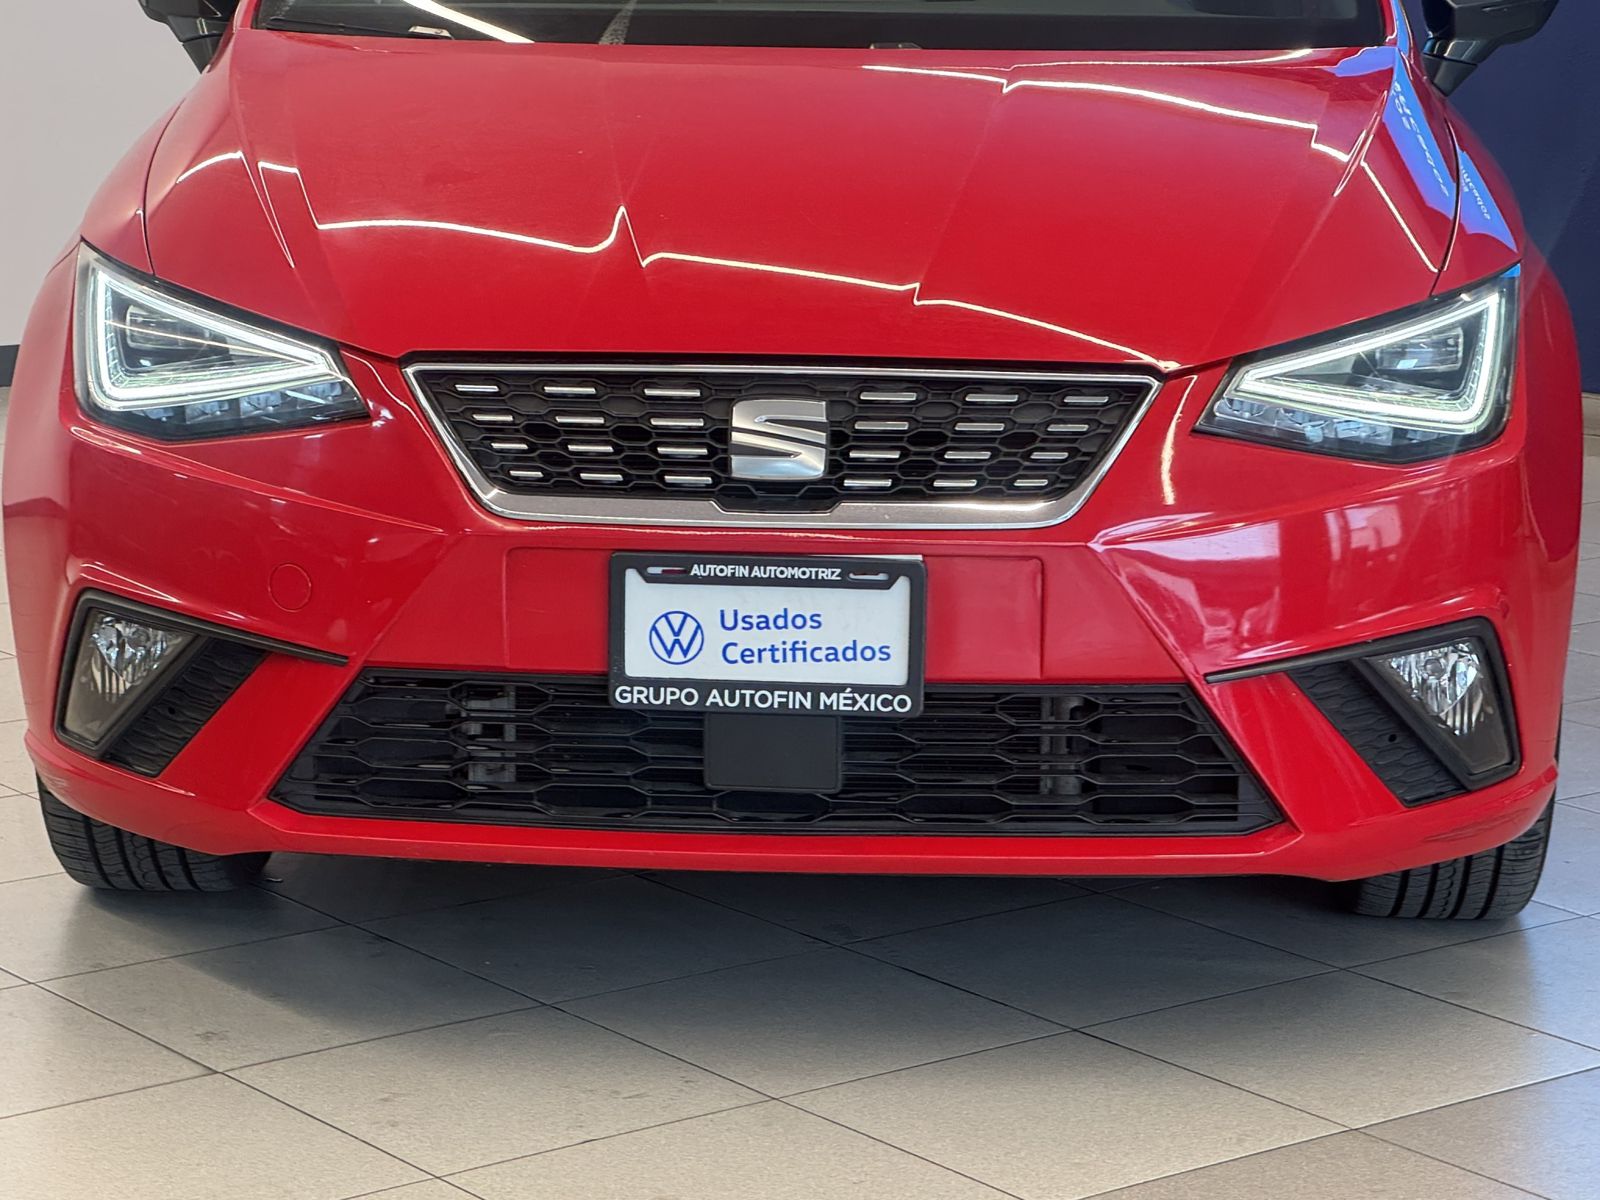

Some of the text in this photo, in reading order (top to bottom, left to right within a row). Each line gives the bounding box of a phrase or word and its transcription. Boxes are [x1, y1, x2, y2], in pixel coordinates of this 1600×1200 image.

[690, 564, 842, 580] AUTOFIN AUTOMOTRIZ
[719, 608, 822, 631] Usados
[721, 640, 892, 664] Certificados
[614, 685, 912, 712] GRUPO AUTOFIN MÉXICO
